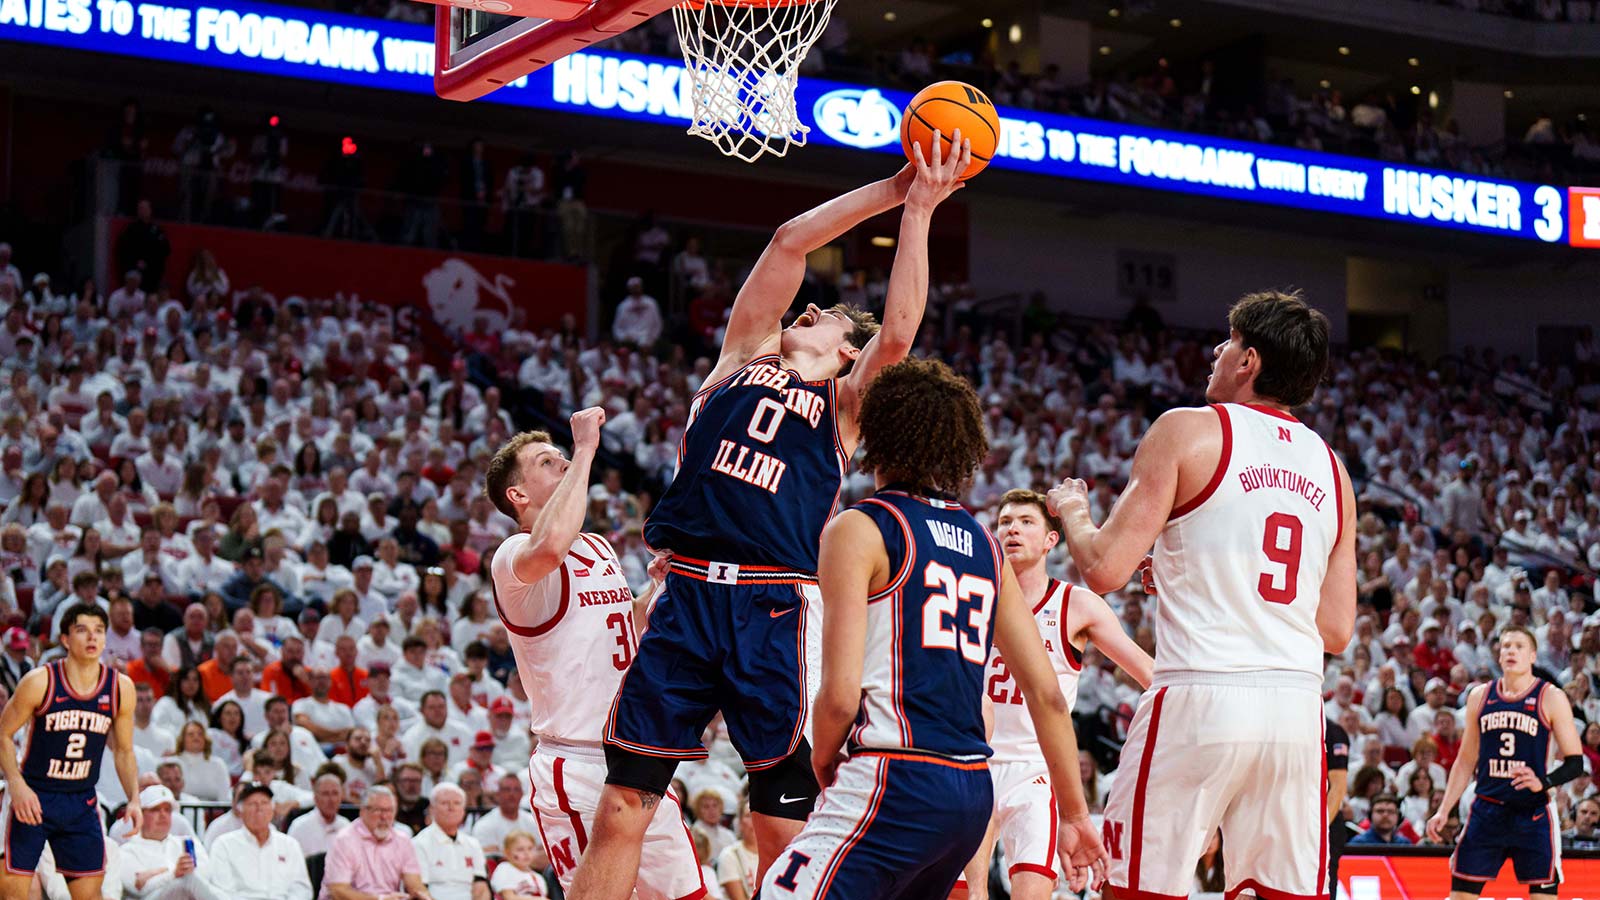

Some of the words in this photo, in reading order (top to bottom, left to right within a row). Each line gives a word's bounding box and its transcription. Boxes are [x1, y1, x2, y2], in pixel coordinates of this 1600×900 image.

[97, 0, 134, 36] TO
[138, 3, 191, 43] THE
[195, 7, 380, 73] FOODBANK
[996, 117, 1046, 162] TES
[1047, 129, 1076, 163] TO
[1076, 133, 1118, 167] THE
[1119, 135, 1256, 190] FOODBANK
[1256, 158, 1306, 193] WITH
[1308, 165, 1368, 201] EVERY
[1383, 167, 1522, 231] HUSKER
[1533, 185, 1563, 242] 3
[728, 363, 825, 430] FIGHING
[747, 397, 786, 444] 0
[1277, 426, 1292, 443] N
[711, 439, 787, 495] ILLINI
[1238, 463, 1327, 512] BÜYÜKTUNCEL
[925, 519, 974, 558] WAGLER
[1257, 511, 1304, 606] 9
[716, 565, 729, 581] I
[577, 586, 632, 608] NEBRAS
[921, 559, 996, 666] 23
[606, 610, 638, 671] 31
[45, 709, 112, 735] FIGHTING
[1480, 710, 1539, 737] FIGHTING
[65, 732, 87, 759] 2
[1499, 732, 1516, 757] 3
[46, 758, 92, 780] ILLINI
[551, 836, 577, 877] N
[1103, 819, 1123, 860] N
[774, 850, 811, 893] I
